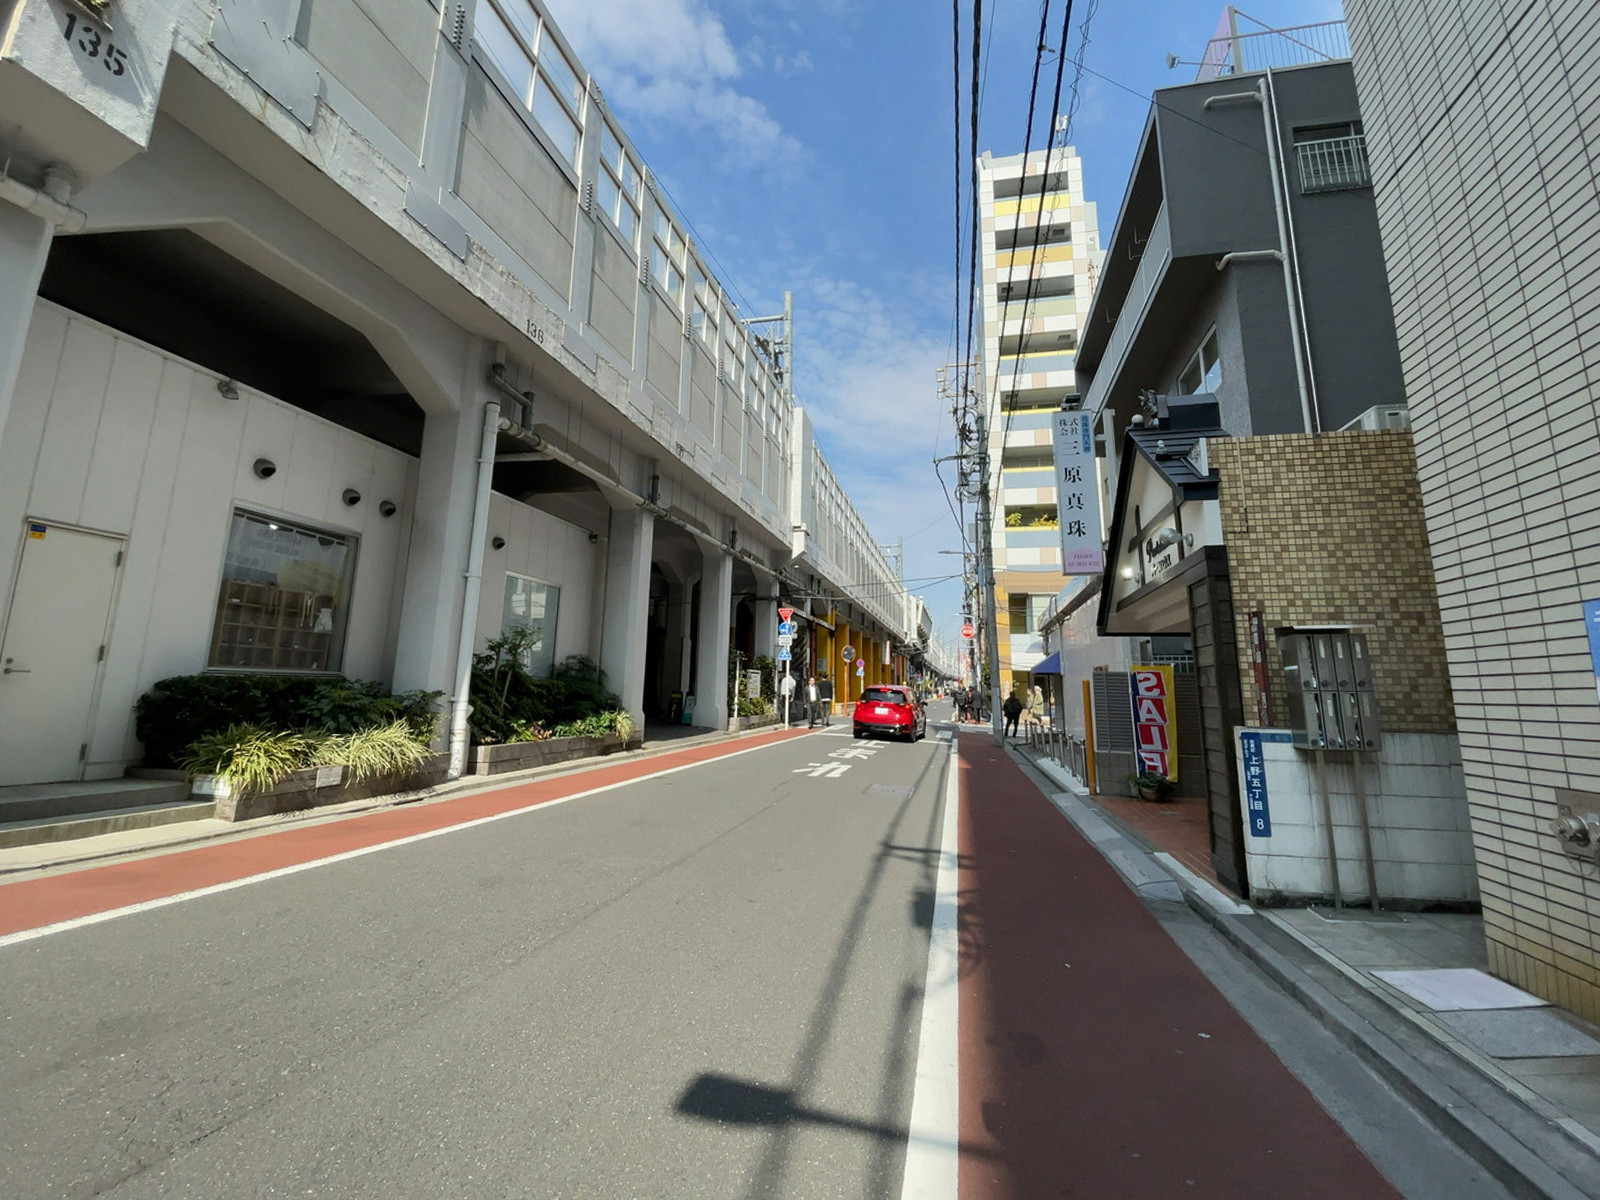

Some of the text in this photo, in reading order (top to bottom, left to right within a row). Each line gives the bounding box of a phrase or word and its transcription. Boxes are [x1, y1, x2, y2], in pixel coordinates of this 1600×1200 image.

[63, 12, 128, 77] 135
[526, 318, 545, 344] 136
[1062, 440, 1087, 538] 三原真珠
[791, 740, 892, 778] 止まれ
[1249, 755, 1263, 811] 上野五丁目
[1256, 818, 1265, 830] 8
